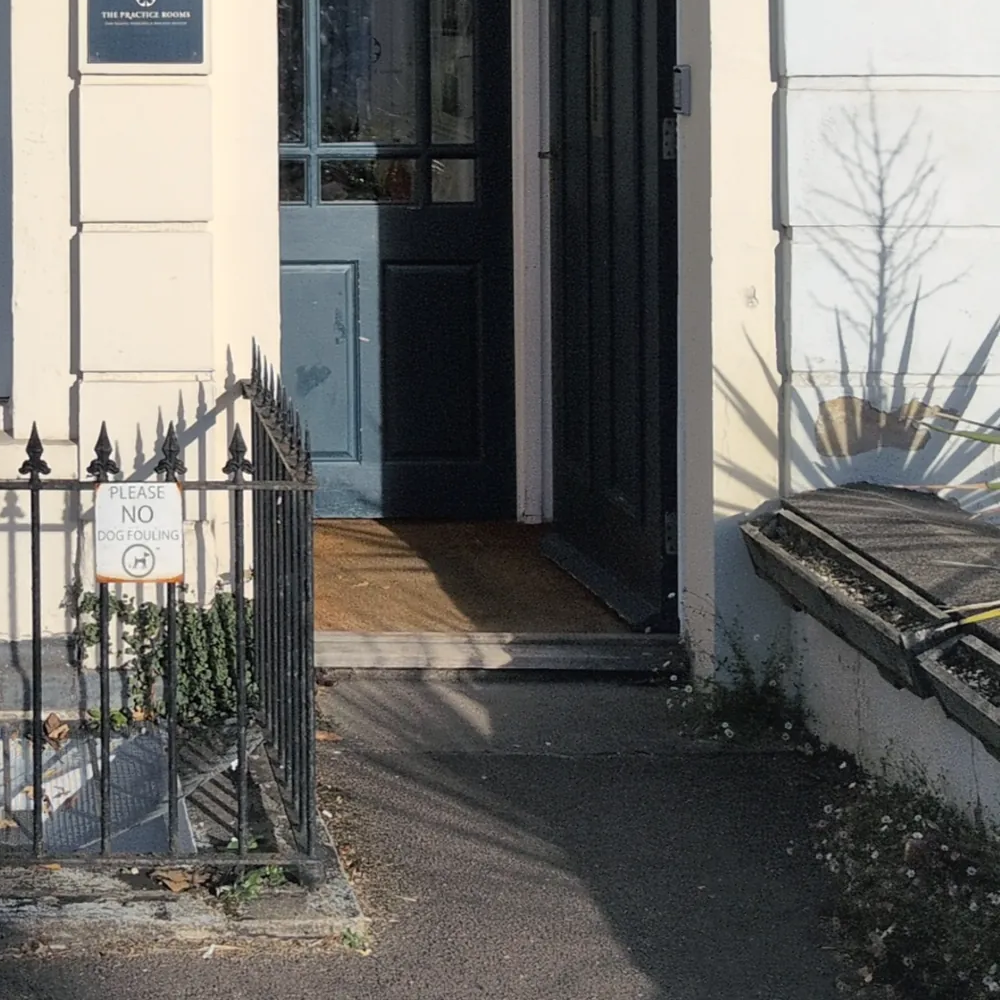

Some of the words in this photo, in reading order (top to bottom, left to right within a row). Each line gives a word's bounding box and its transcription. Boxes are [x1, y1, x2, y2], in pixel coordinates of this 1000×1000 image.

[102, 11, 117, 19] THE
[120, 11, 159, 20] PRACTICE
[161, 11, 191, 19] ROOMS
[109, 485, 165, 500] PLEASE
[122, 504, 154, 524] NO
[97, 530, 125, 541] DOG
[127, 530, 180, 541] FOULING
